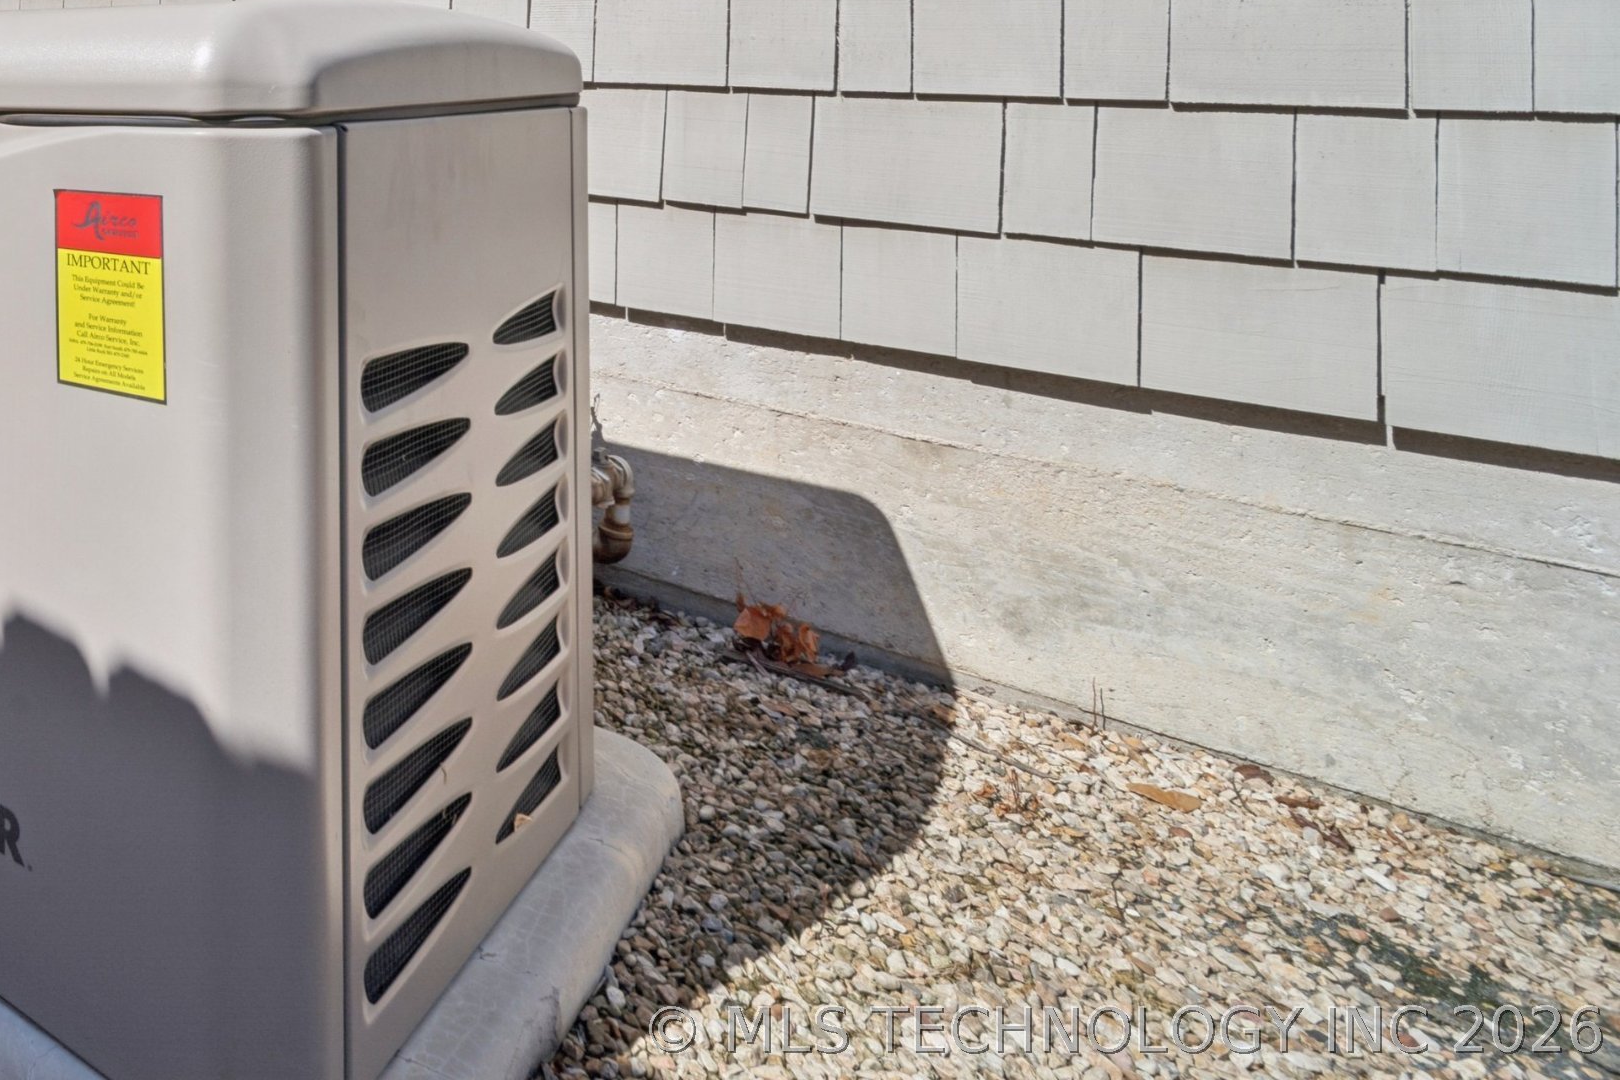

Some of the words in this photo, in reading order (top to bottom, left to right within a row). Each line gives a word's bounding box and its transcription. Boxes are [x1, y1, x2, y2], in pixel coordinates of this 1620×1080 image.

[66, 253, 151, 275] IMPORTANT
[71, 274, 84, 282] This
[84, 276, 116, 287] Equipment
[117, 279, 136, 289] Could
[136, 282, 144, 290] Be
[73, 283, 91, 292] Under
[92, 286, 120, 297] Warranty
[79, 293, 100, 303] Service
[88, 313, 98, 321] For
[99, 314, 127, 326] Warranty
[76, 330, 88, 338] Call
[86, 322, 106, 332] Service
[107, 325, 143, 338] Information
[94, 360, 122, 370] Emergency
[82, 365, 101, 374] Repairs
[117, 372, 136, 381] Models
[73, 371, 91, 380] Service
[122, 381, 146, 391] Available
